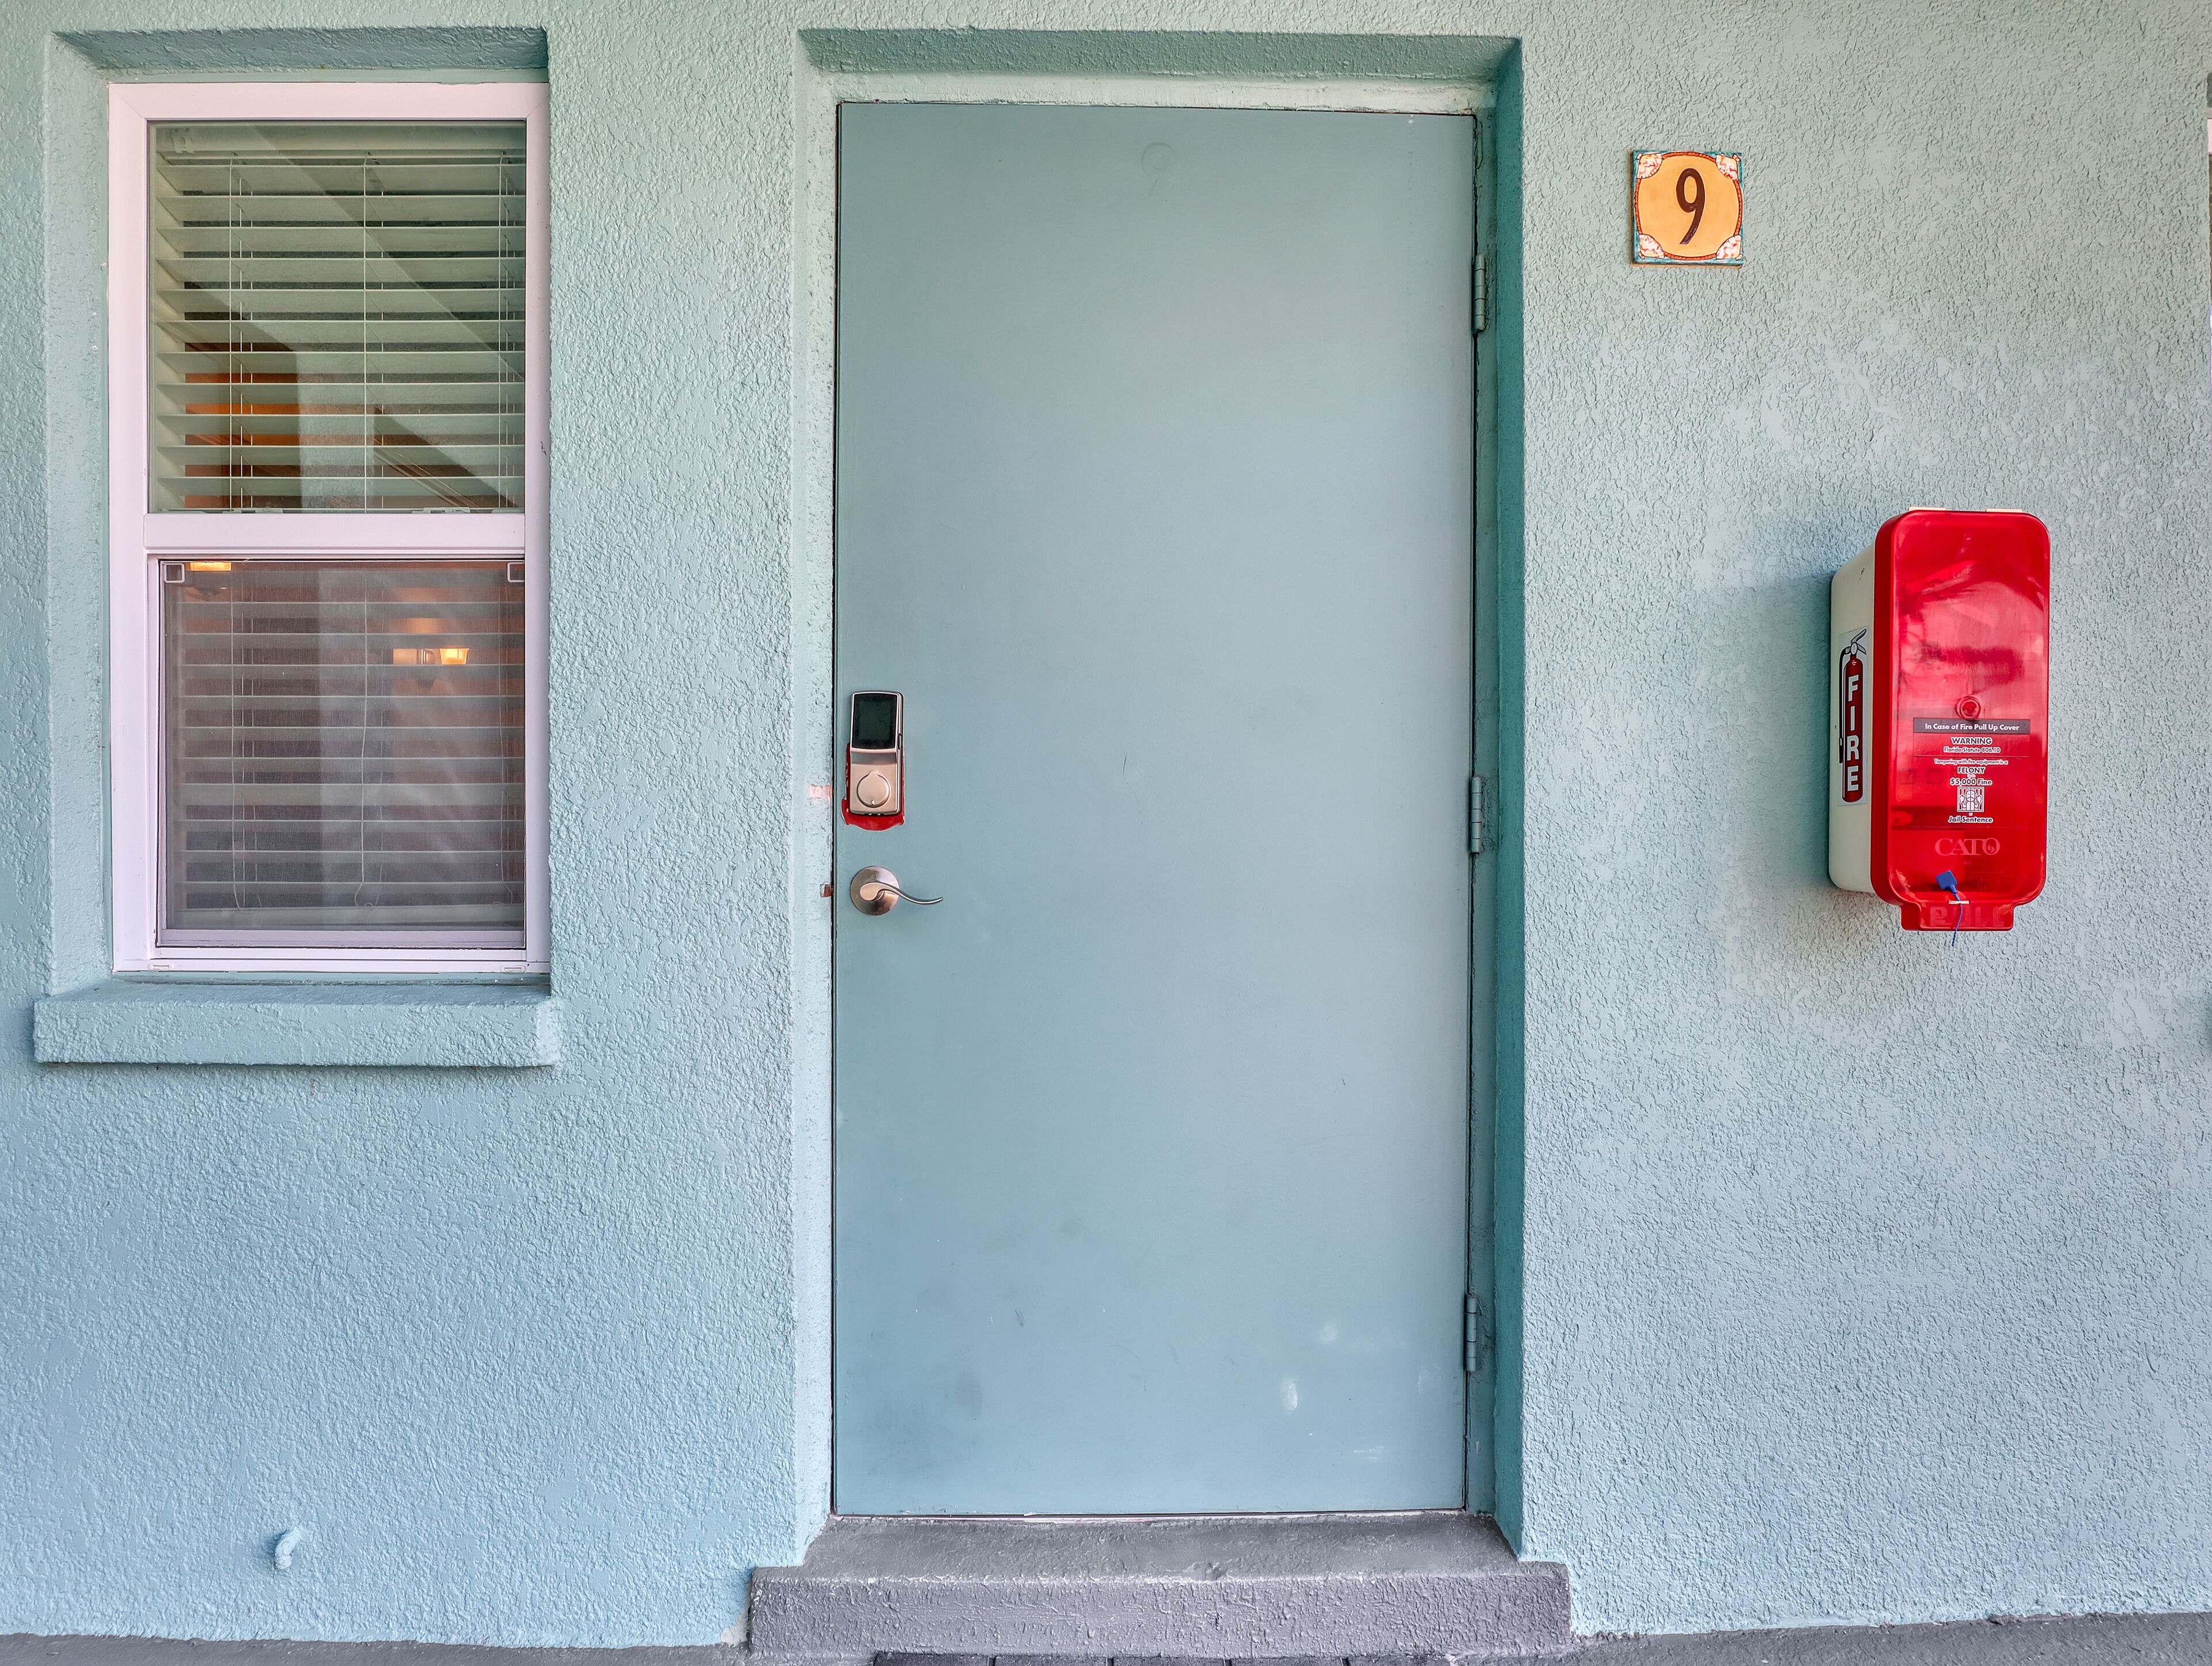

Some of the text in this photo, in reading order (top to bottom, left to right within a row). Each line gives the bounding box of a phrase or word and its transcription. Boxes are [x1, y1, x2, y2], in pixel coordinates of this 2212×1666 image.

[1676, 168, 1706, 245] 9
[1846, 674, 1860, 792] FIRE
[1950, 778, 1976, 786] $5,000
[1934, 837, 2001, 856] CATO
